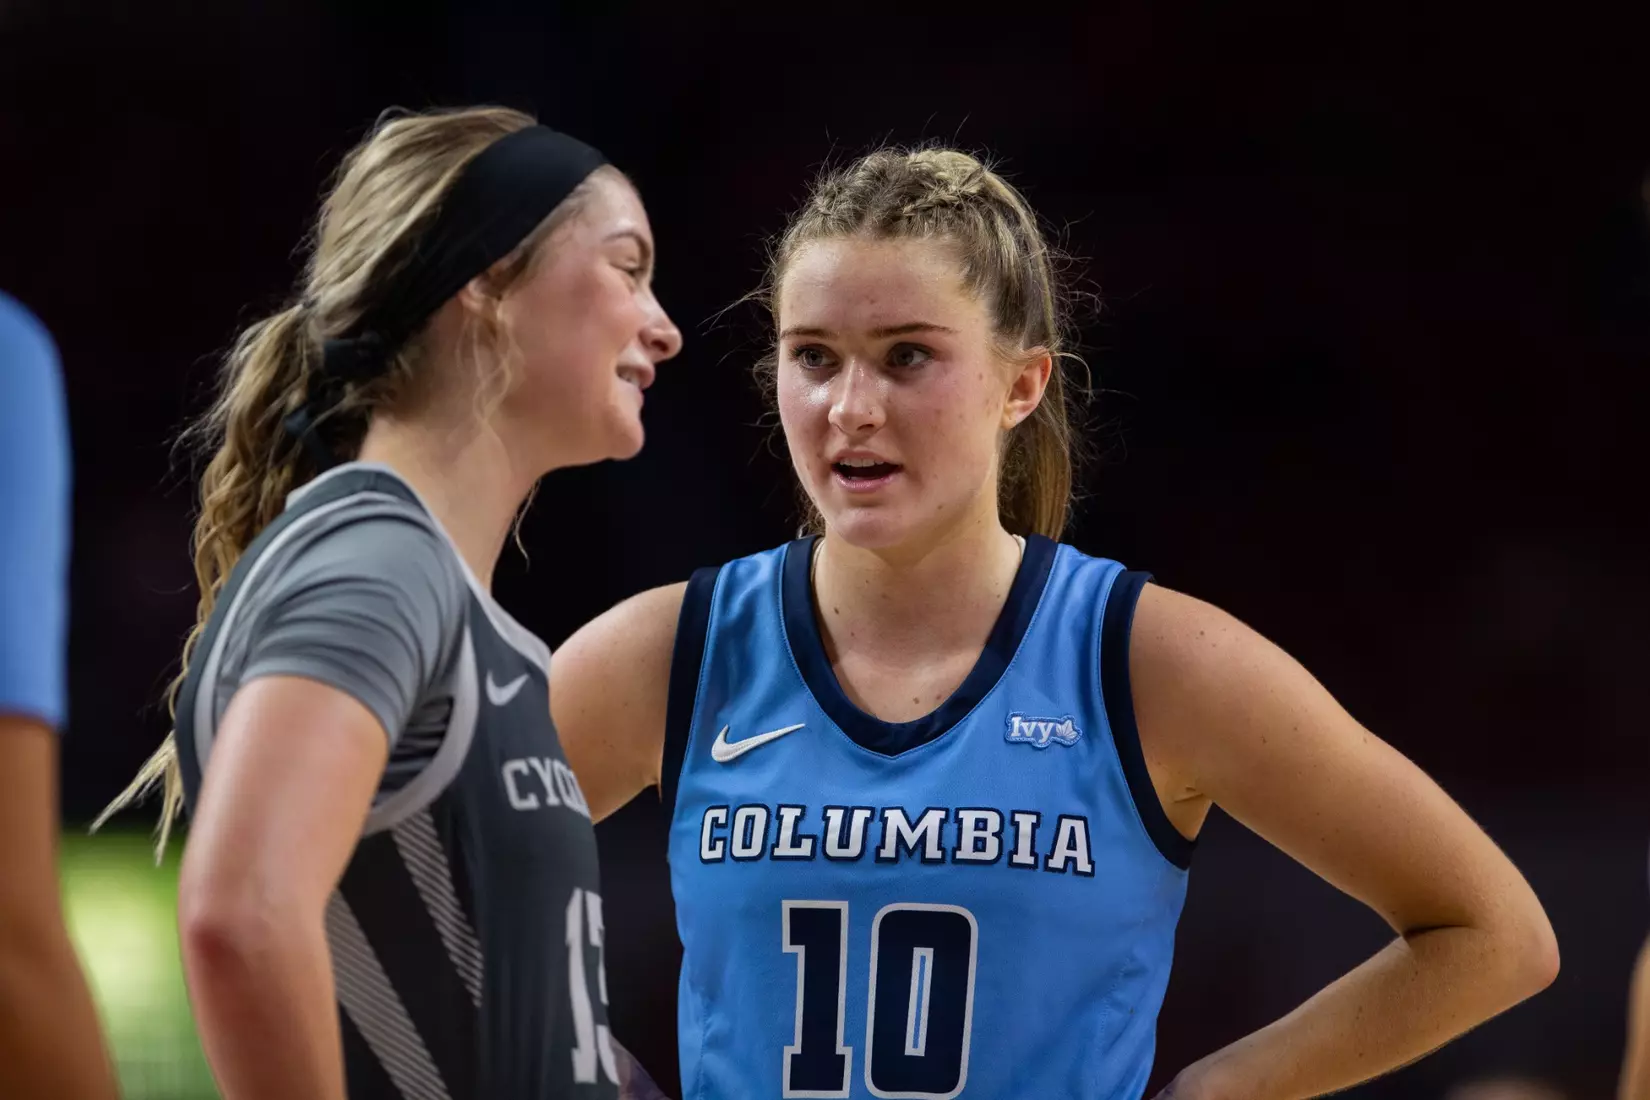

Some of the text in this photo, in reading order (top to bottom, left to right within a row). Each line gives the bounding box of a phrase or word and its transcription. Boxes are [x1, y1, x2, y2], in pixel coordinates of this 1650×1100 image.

[1010, 716, 1054, 742] Ivy
[699, 803, 1095, 876] COLUMBIA
[781, 899, 979, 1100] 10
